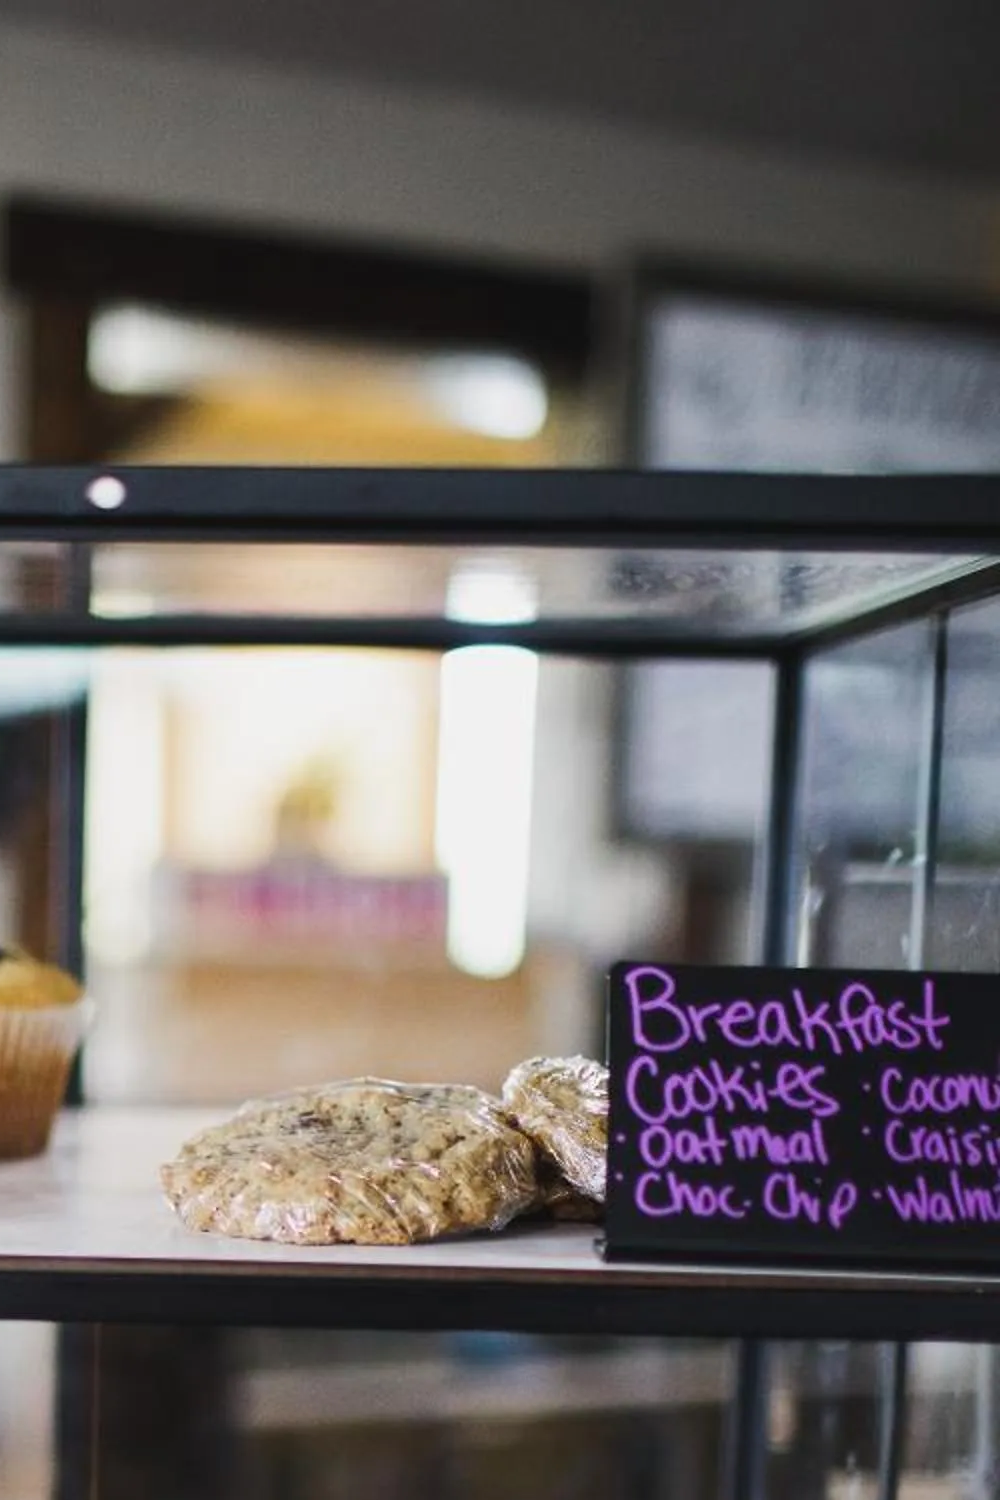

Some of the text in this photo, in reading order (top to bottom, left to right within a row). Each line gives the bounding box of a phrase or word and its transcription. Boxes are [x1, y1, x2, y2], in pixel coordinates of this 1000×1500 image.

[624, 966, 951, 1055] Breakfast
[626, 1055, 840, 1125] Cookies
[880, 1067, 1000, 1114] Coconu
[885, 1119, 1000, 1167] Craisi
[763, 1172, 858, 1229] Chip
[886, 1169, 1000, 1222] Walnu
